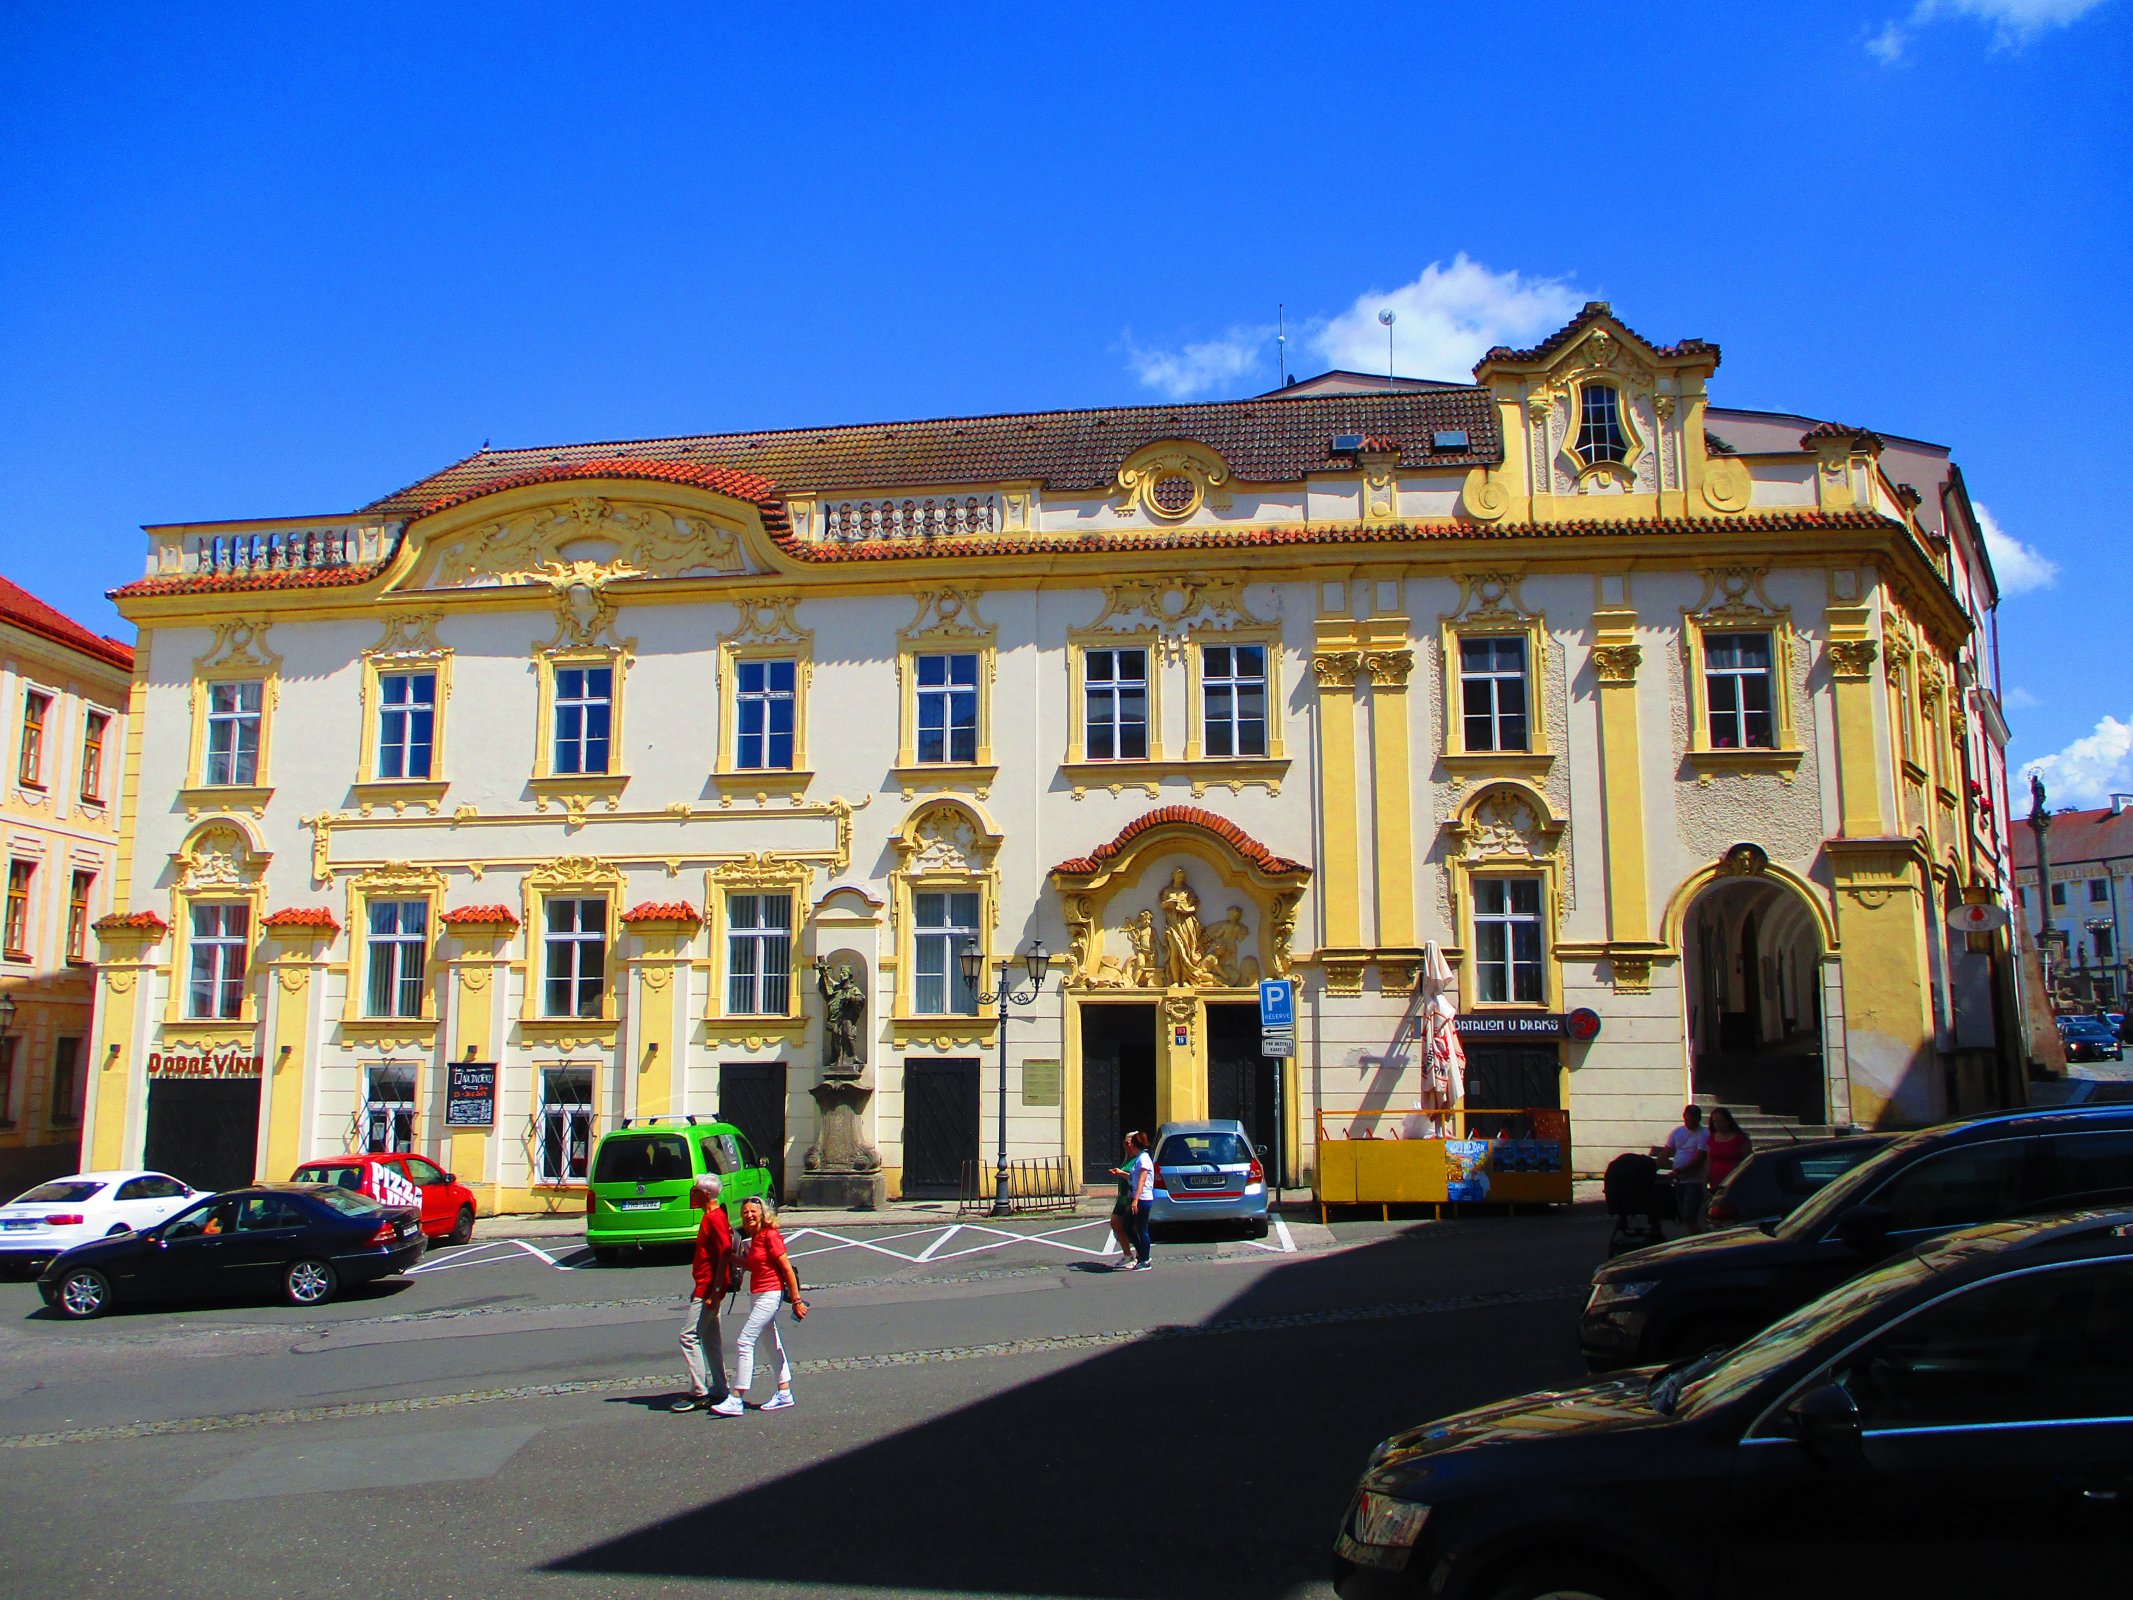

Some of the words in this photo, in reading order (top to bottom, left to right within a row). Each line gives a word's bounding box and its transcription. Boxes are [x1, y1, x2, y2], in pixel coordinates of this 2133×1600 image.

[1266, 986, 1284, 1011] P
[1453, 1019, 1504, 1031] BATALION
[1508, 1019, 1516, 1031] U
[148, 1050, 213, 1074] DOBRÉ
[370, 1161, 423, 1213] PIZZA
